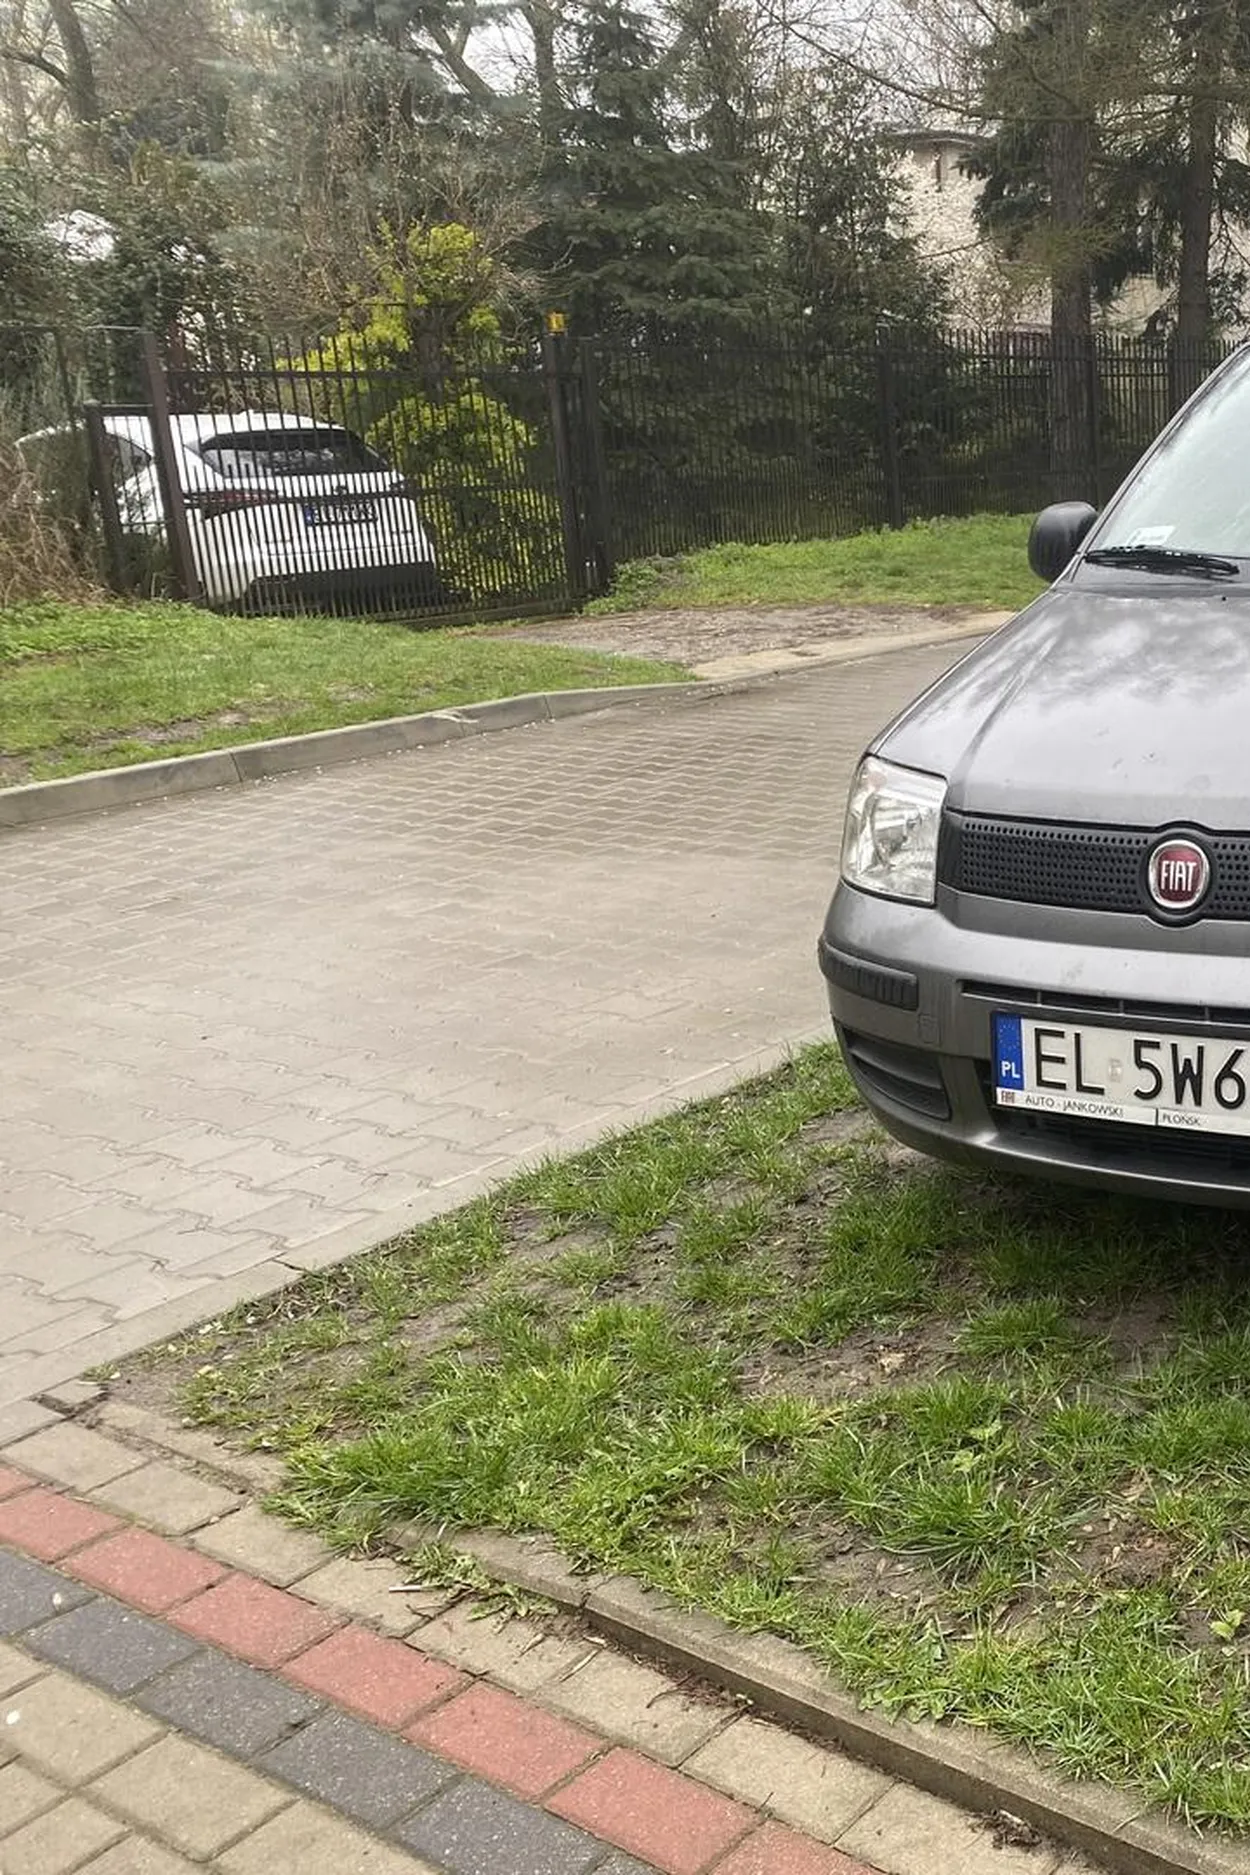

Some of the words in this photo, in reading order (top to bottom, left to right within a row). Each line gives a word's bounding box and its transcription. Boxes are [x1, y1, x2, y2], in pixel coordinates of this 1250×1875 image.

[1160, 860, 1197, 891] FIAT
[1001, 1061, 1020, 1079] PL
[1034, 1027, 1105, 1095] EL
[1025, 1095, 1055, 1108] AUTO
[1063, 1100, 1124, 1118] JANKOWSKI
